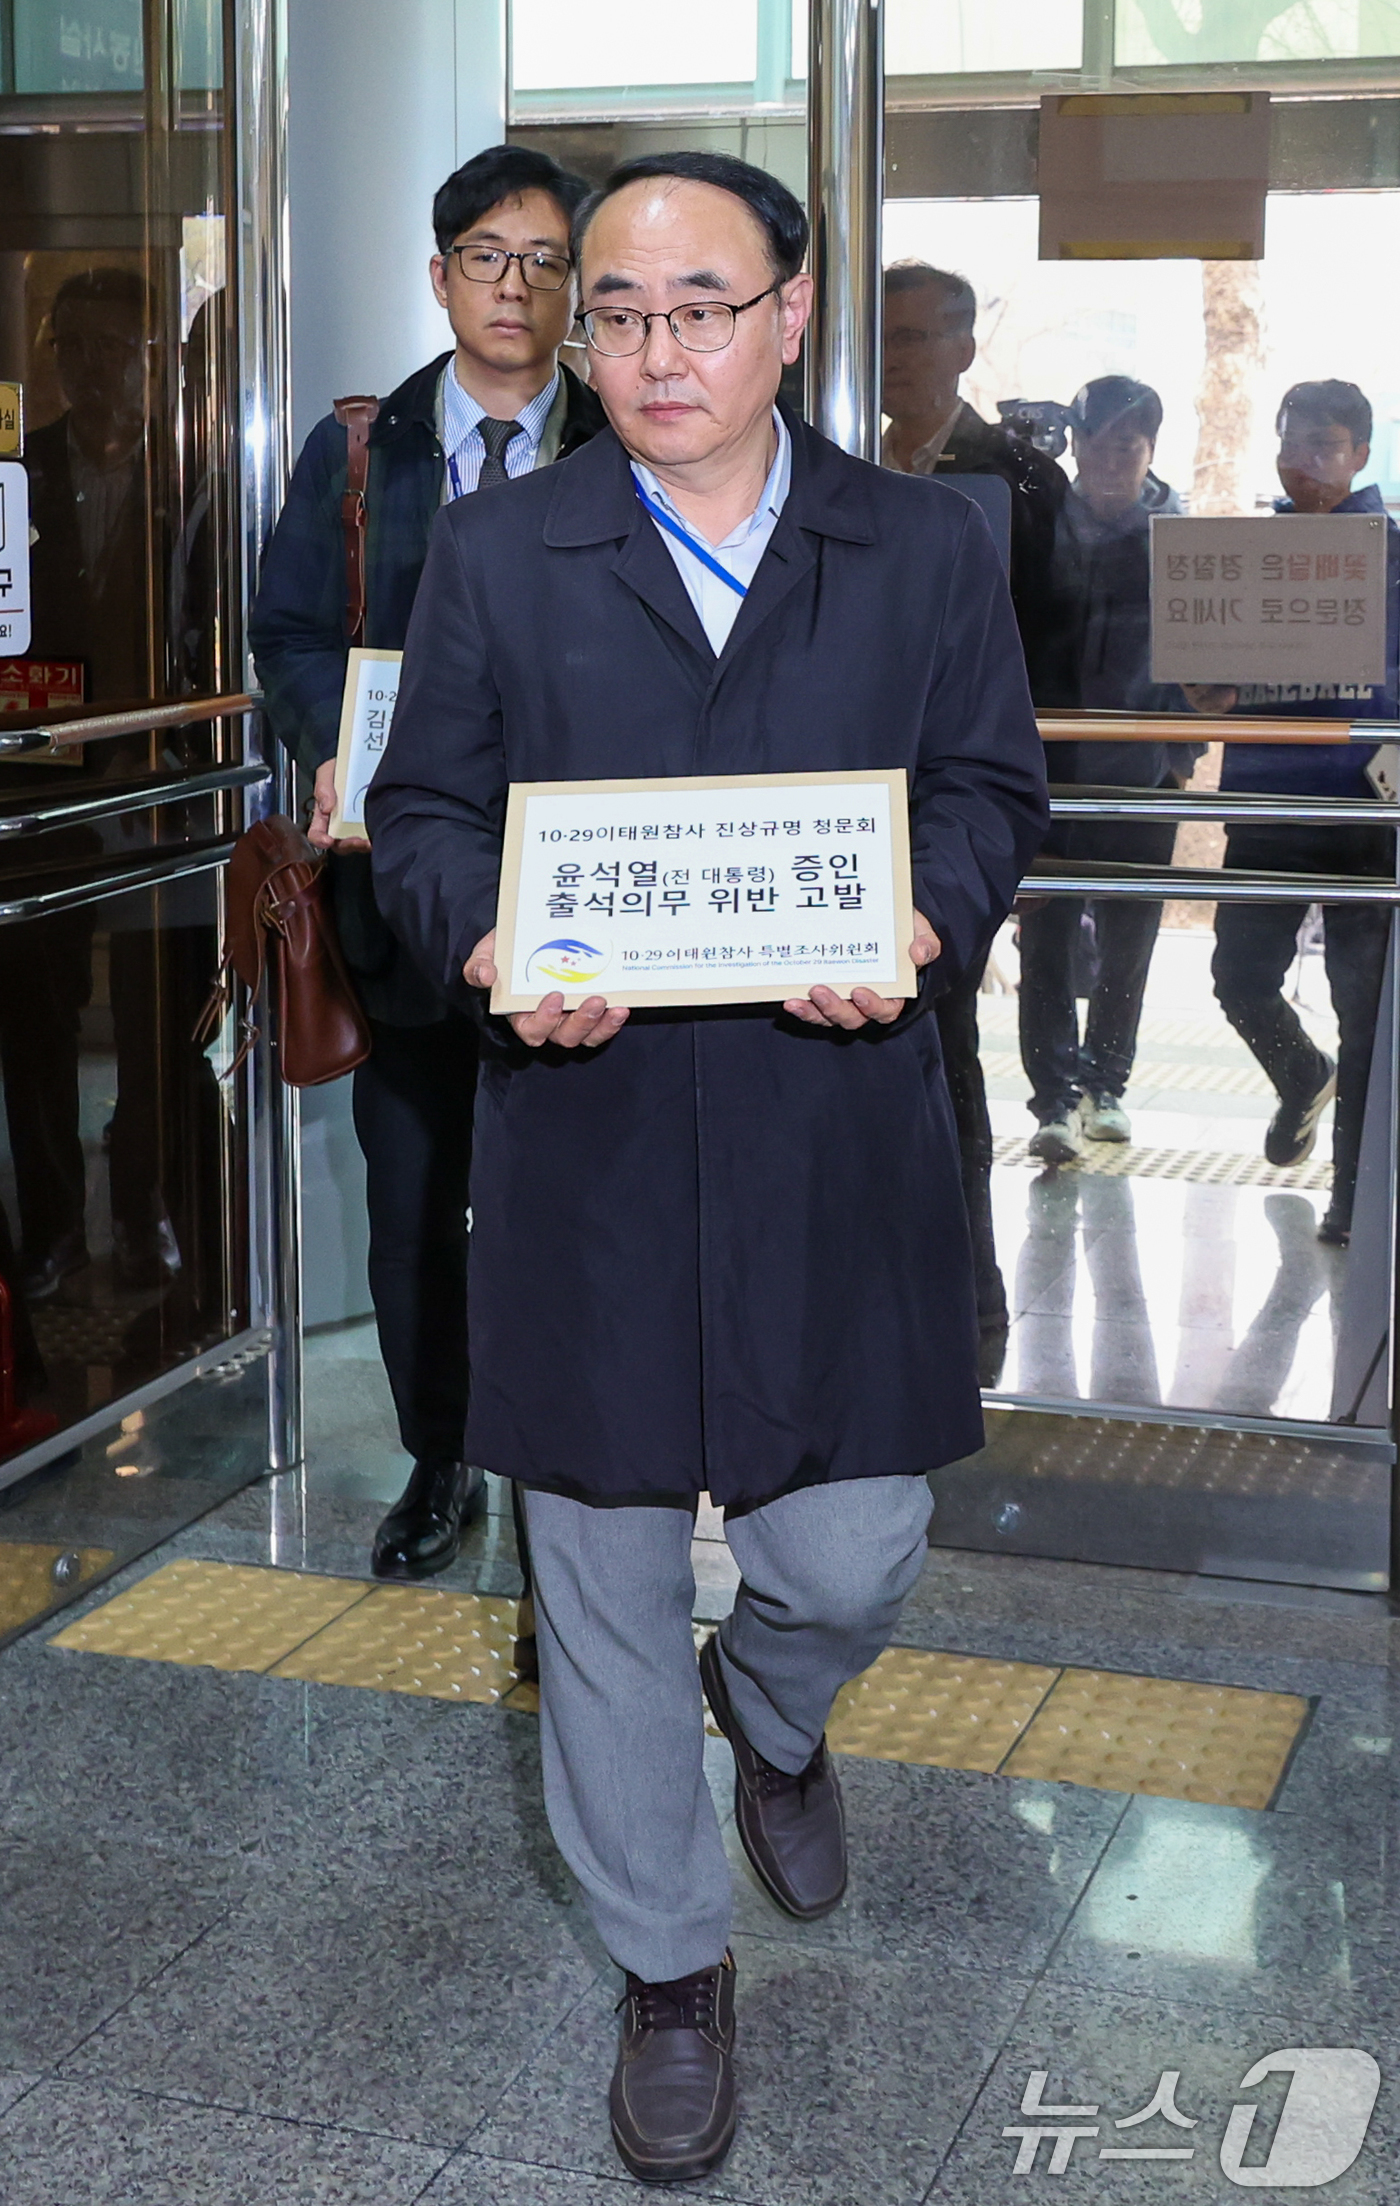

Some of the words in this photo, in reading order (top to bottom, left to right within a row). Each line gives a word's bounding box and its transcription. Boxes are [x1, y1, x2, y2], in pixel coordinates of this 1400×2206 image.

[1, 664, 77, 686] 소화기
[537, 823, 706, 843] 10·29이태원참사
[715, 820, 802, 838] 진상규명
[812, 817, 877, 835] 청문회
[552, 860, 691, 889] 윤석열(전
[701, 866, 776, 884] 대통령)
[790, 853, 860, 882] 증인
[545, 890, 692, 919] 출석의무
[707, 886, 780, 914] 위반
[795, 882, 867, 911] 고발
[758, 942, 879, 958] 특별조사위원회
[652, 963, 694, 971] Commission
[694, 961, 704, 969] for
[705, 961, 717, 969] the
[718, 960, 761, 969] Investigation
[771, 958, 782, 966] the
[784, 957, 812, 965] October
[813, 957, 822, 965] 29
